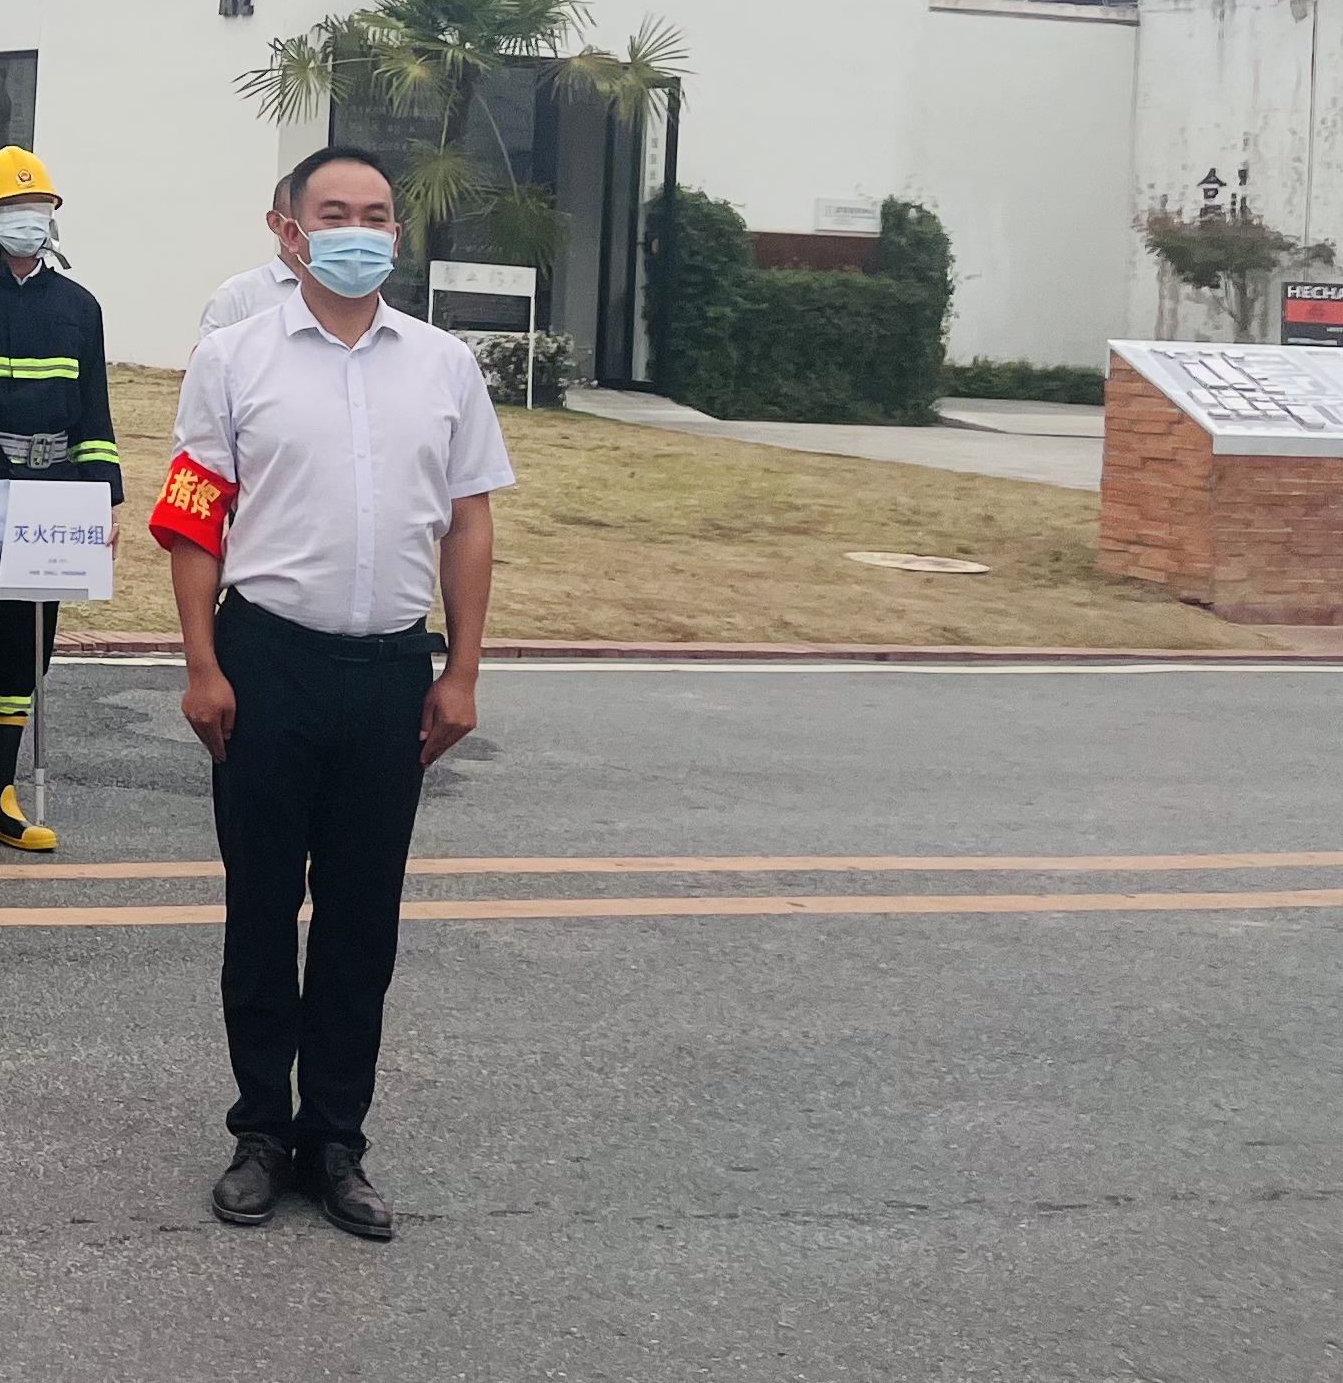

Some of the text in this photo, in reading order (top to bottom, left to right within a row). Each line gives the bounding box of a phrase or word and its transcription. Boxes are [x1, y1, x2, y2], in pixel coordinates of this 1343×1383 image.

[13, 524, 105, 545] 灭火行动组
